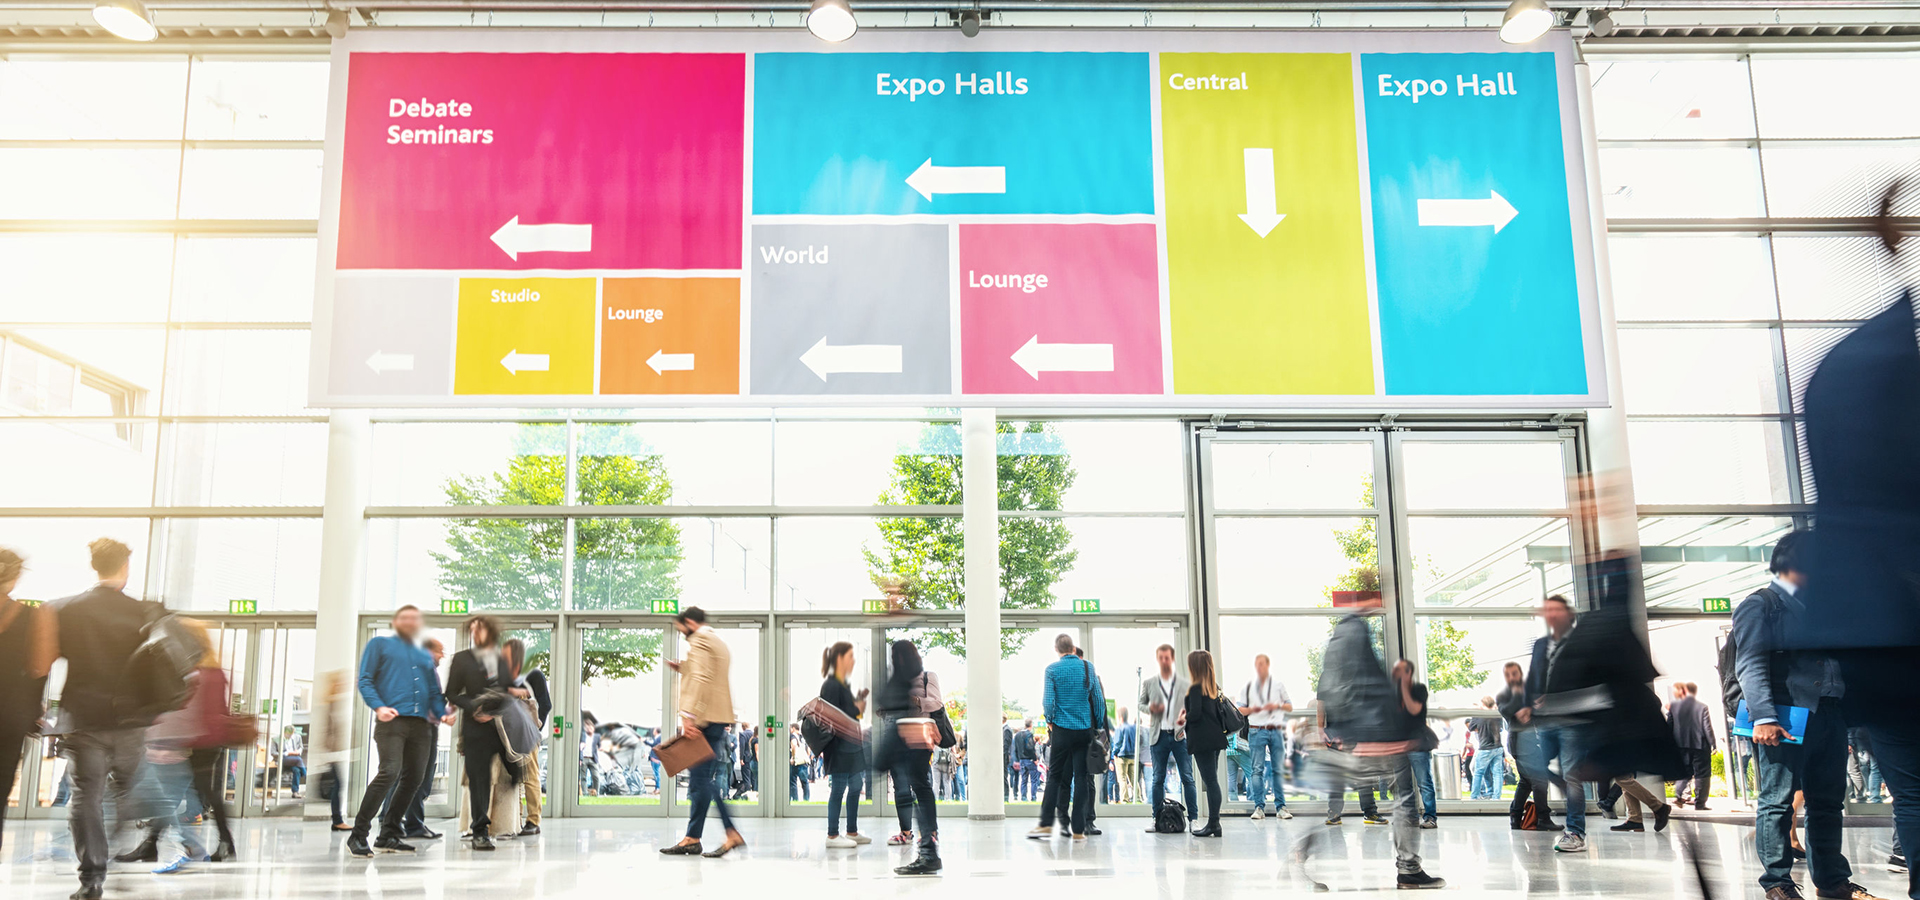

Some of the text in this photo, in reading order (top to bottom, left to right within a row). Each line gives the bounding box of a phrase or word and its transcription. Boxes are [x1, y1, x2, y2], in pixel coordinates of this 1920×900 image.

[876, 71, 1028, 102] Expo Halls
[1168, 72, 1248, 92] Central
[1378, 72, 1517, 103] Expo Hall
[388, 97, 472, 117] Debate
[387, 124, 493, 145] Seminars
[760, 246, 829, 264] World
[968, 270, 1048, 293] Lounge
[490, 288, 540, 303] Studio
[607, 306, 664, 323] Lounge
